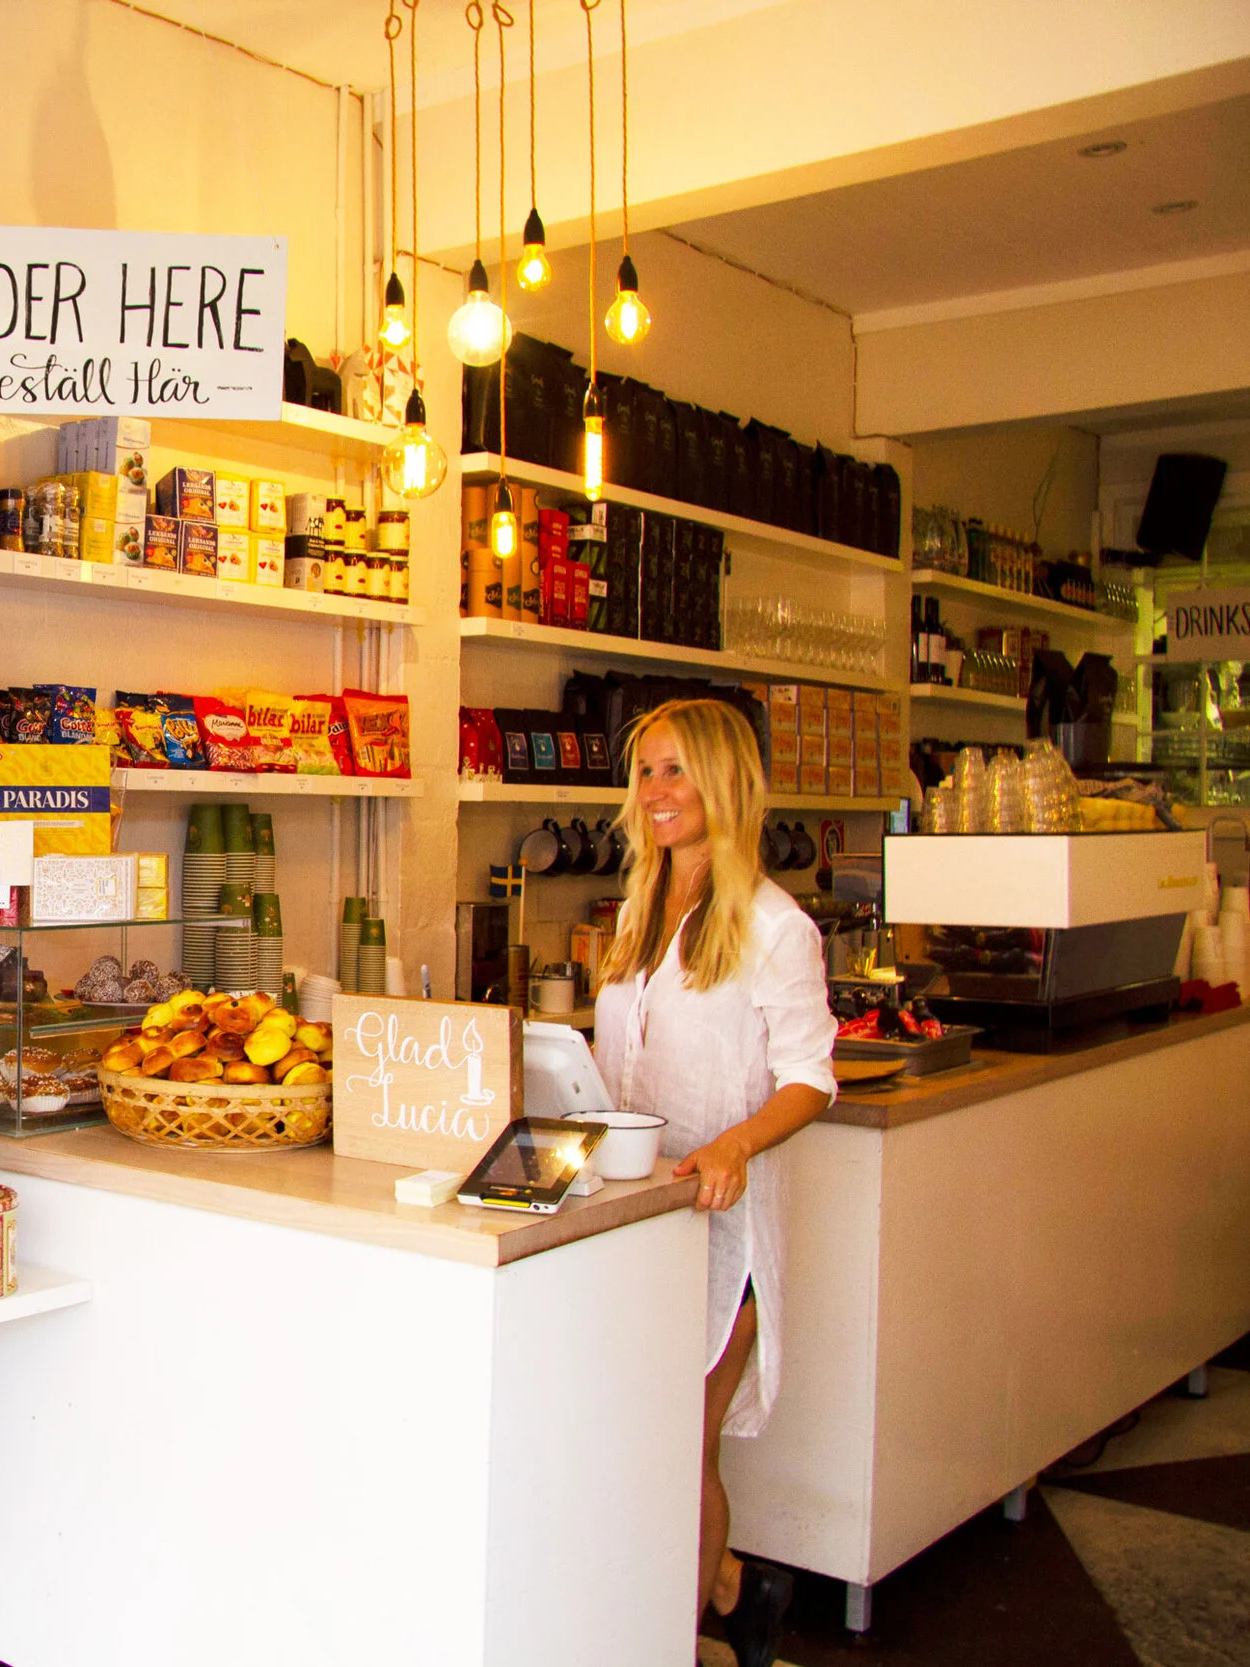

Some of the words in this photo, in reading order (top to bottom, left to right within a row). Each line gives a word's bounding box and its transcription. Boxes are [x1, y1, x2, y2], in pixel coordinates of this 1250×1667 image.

[119, 262, 265, 353] HERE
[126, 357, 210, 405] Här
[1175, 602, 1250, 640] DRINKS
[248, 705, 285, 728] bilar
[289, 713, 326, 735] bilar
[2, 790, 90, 809] PARADIS
[343, 1011, 472, 1088] Glad
[347, 1073, 490, 1142] Lucia
